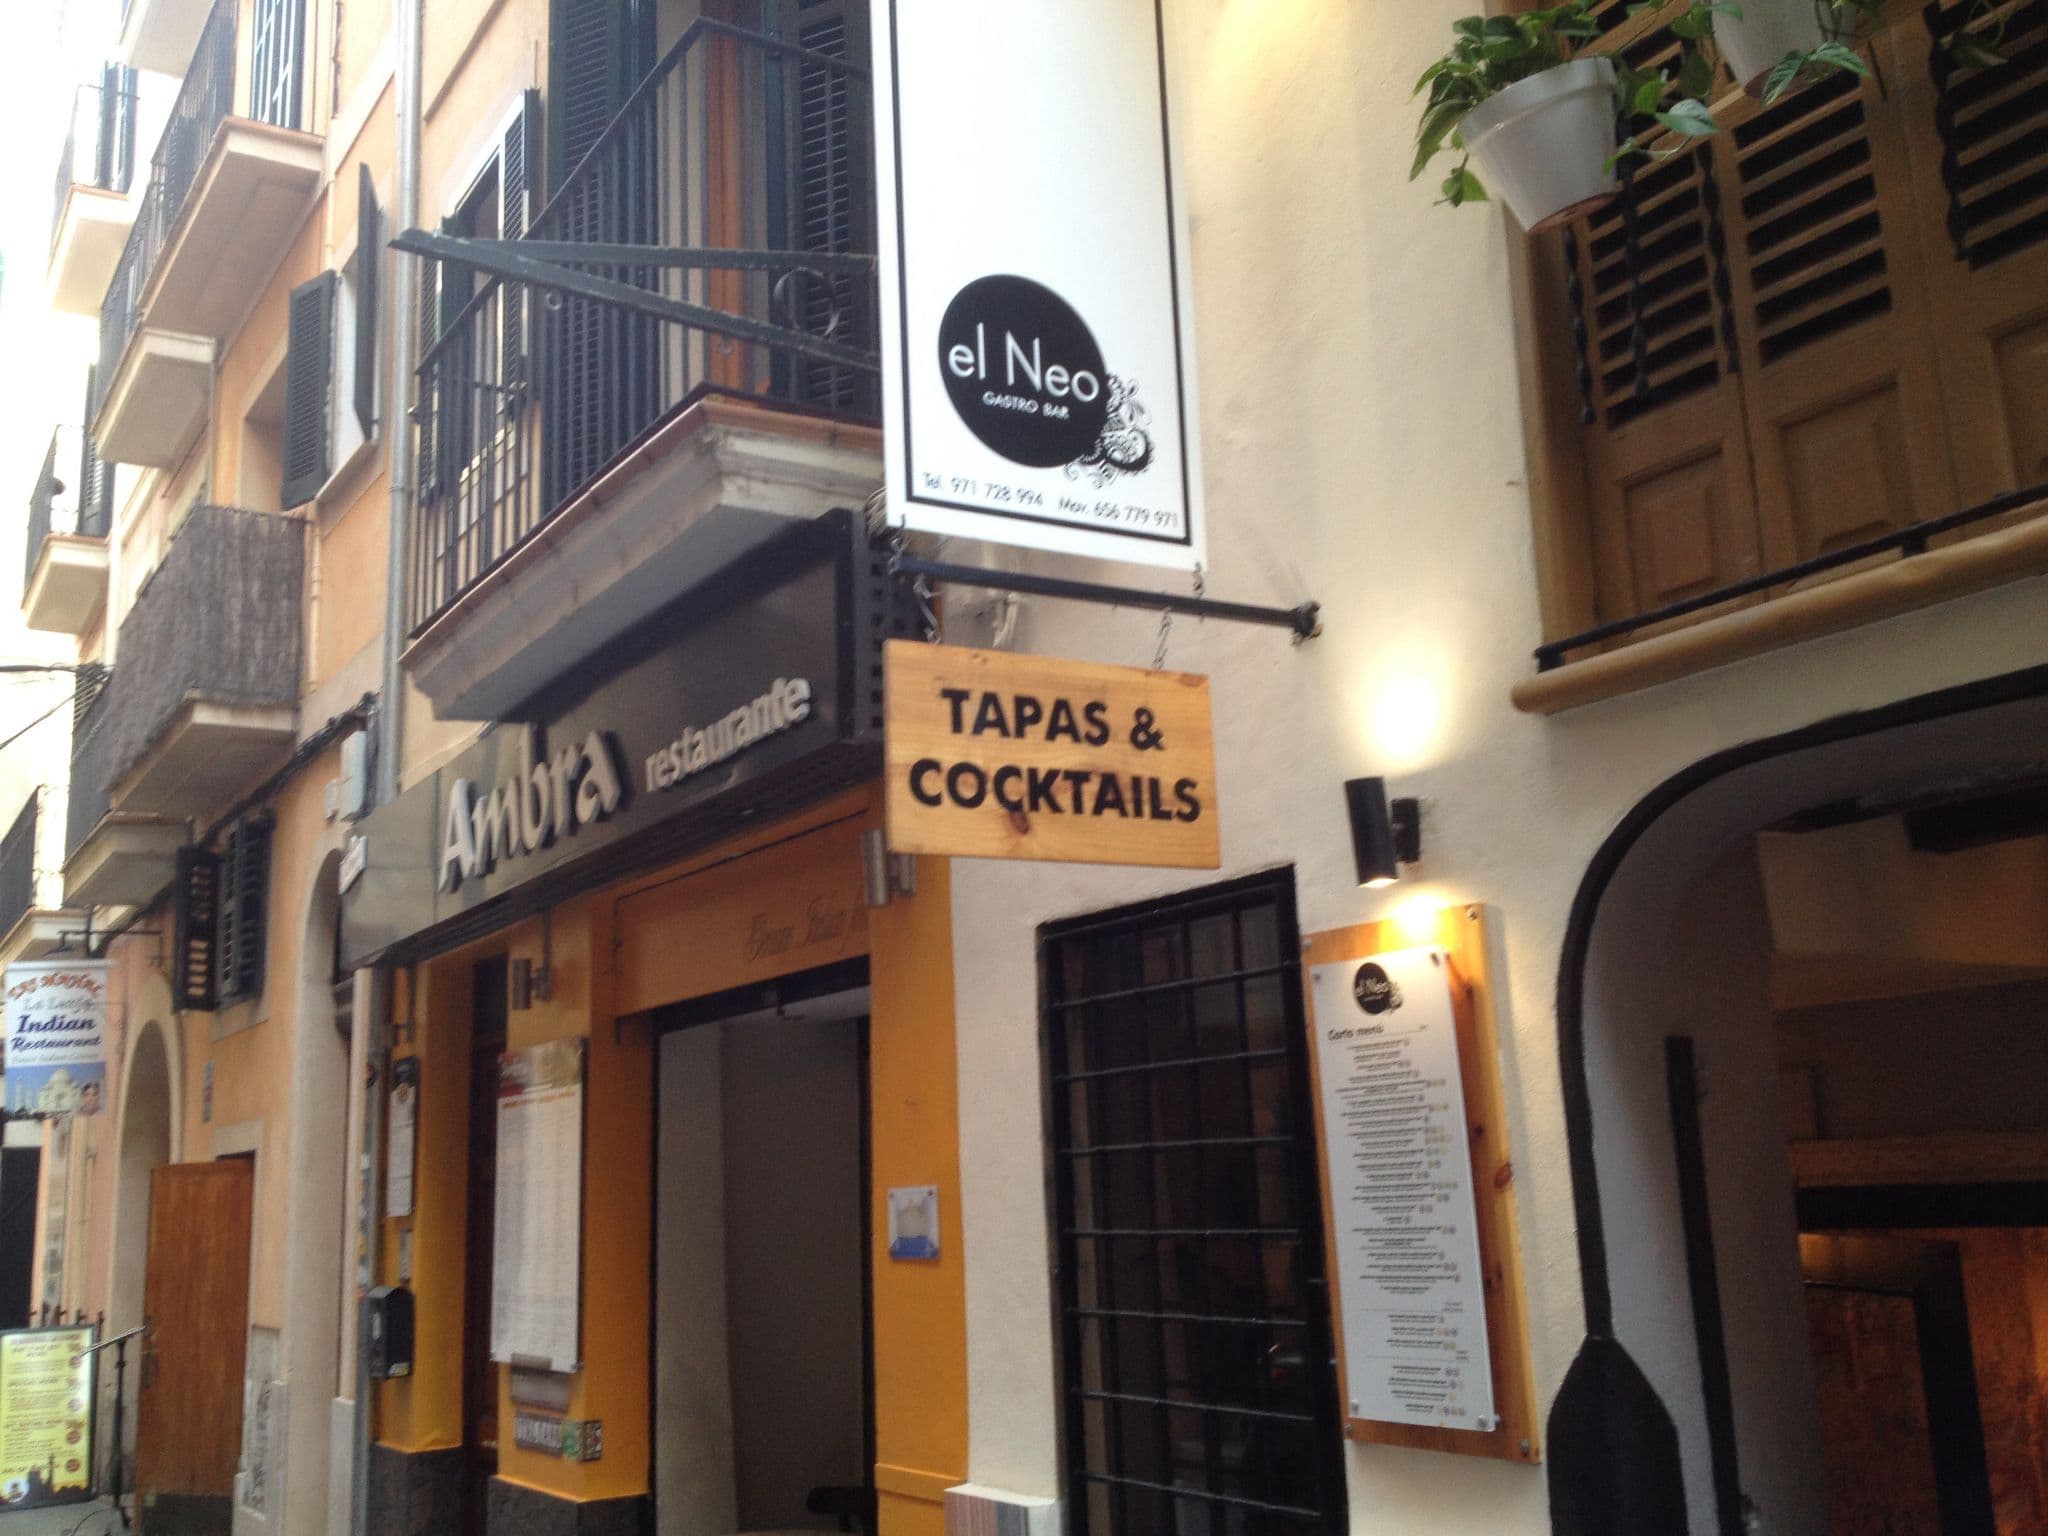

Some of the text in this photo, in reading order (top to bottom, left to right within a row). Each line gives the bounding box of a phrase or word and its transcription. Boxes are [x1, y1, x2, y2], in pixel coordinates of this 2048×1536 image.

[949, 322, 1099, 402] el Neo
[982, 390, 1070, 420] GASTRO BAR
[951, 477, 976, 495] 971
[1122, 505, 1150, 524] 779
[1153, 510, 1178, 528] 971
[645, 676, 811, 792] restaurante
[940, 688, 1165, 750] TAPAS &
[438, 721, 621, 892] Ambra
[909, 758, 1202, 823] COCKTAILS
[11, 1036, 102, 1052] Restaurant
[17, 1014, 96, 1034] Indian
